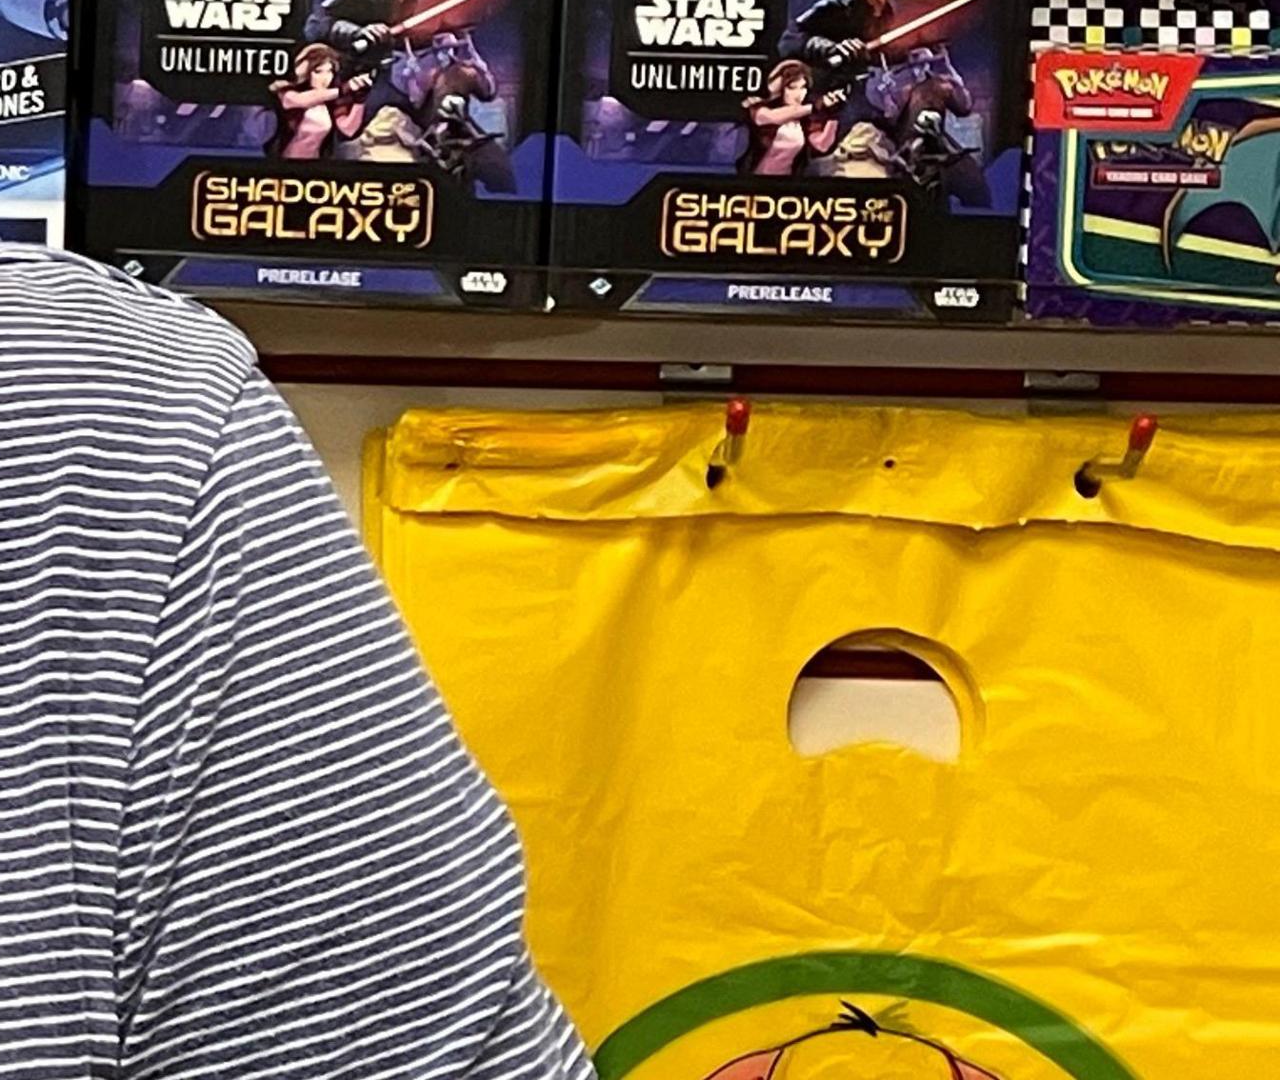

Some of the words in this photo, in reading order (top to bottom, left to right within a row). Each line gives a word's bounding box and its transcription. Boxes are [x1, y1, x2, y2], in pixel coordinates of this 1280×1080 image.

[164, 1, 291, 31] WARS
[635, 18, 764, 47] WARS
[161, 46, 288, 75] UNLIMITED
[21, 65, 39, 88] &
[631, 63, 762, 92] UNLIMITED
[205, 177, 384, 206] SHADOWS
[392, 182, 416, 195] OF
[389, 194, 420, 207] THE
[675, 193, 857, 220] SHADOWS
[866, 198, 889, 210] OF
[861, 209, 893, 222] THE
[203, 206, 420, 243] GALAXY
[673, 219, 893, 258] GALAXY
[258, 268, 362, 287] PRERELEASE
[728, 284, 832, 302] PRERELEASE
